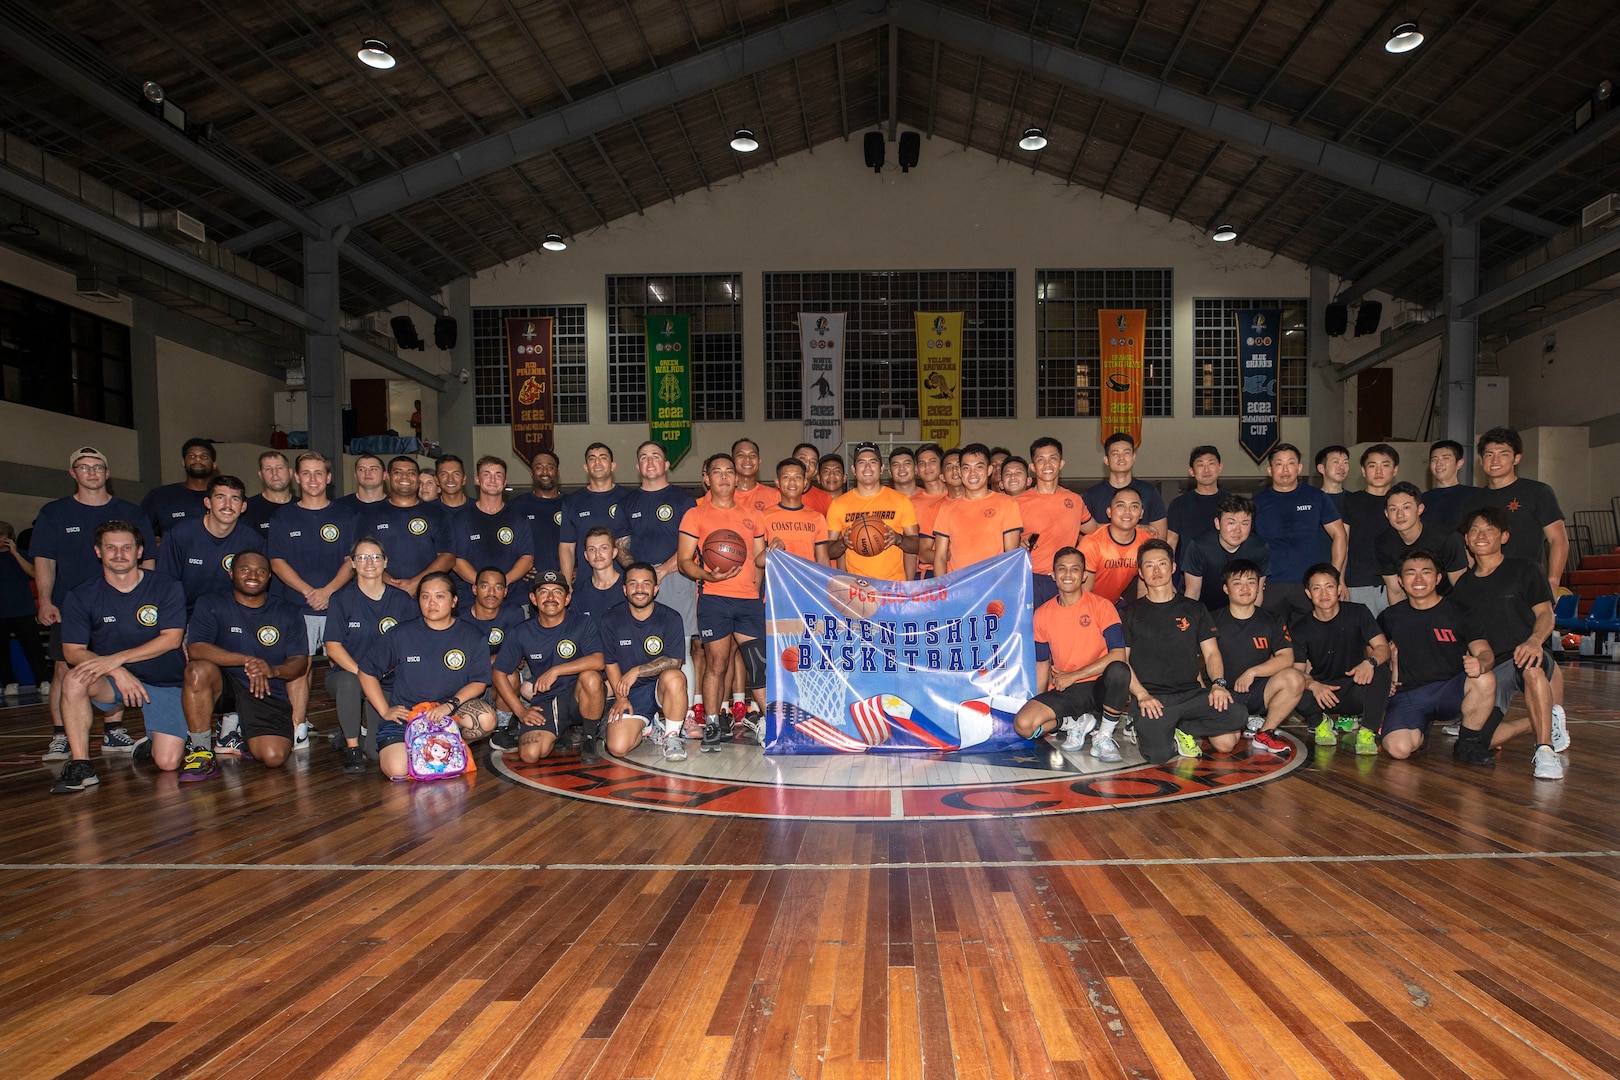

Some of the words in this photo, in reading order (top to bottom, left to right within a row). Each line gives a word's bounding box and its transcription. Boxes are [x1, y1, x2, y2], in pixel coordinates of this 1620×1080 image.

[516, 368, 546, 376] PIRANHA
[655, 366, 684, 374] WALRUS
[658, 407, 684, 418] 2022
[810, 405, 834, 416] 2022
[928, 405, 952, 416] 2022
[1110, 402, 1133, 414] 2022
[1247, 402, 1272, 413] 2022
[521, 410, 544, 421] 2022
[814, 428, 832, 439] CUP
[930, 428, 949, 439] CUP
[1250, 424, 1268, 435] CUP
[662, 430, 680, 441] CUP
[772, 522, 792, 531] COAST
[794, 522, 816, 532] GUARD
[1124, 558, 1138, 568] GUA
[701, 629, 713, 637] PCG
[802, 612, 1000, 645] FRIENDSHIP
[798, 644, 1007, 674] BASKETBALL
